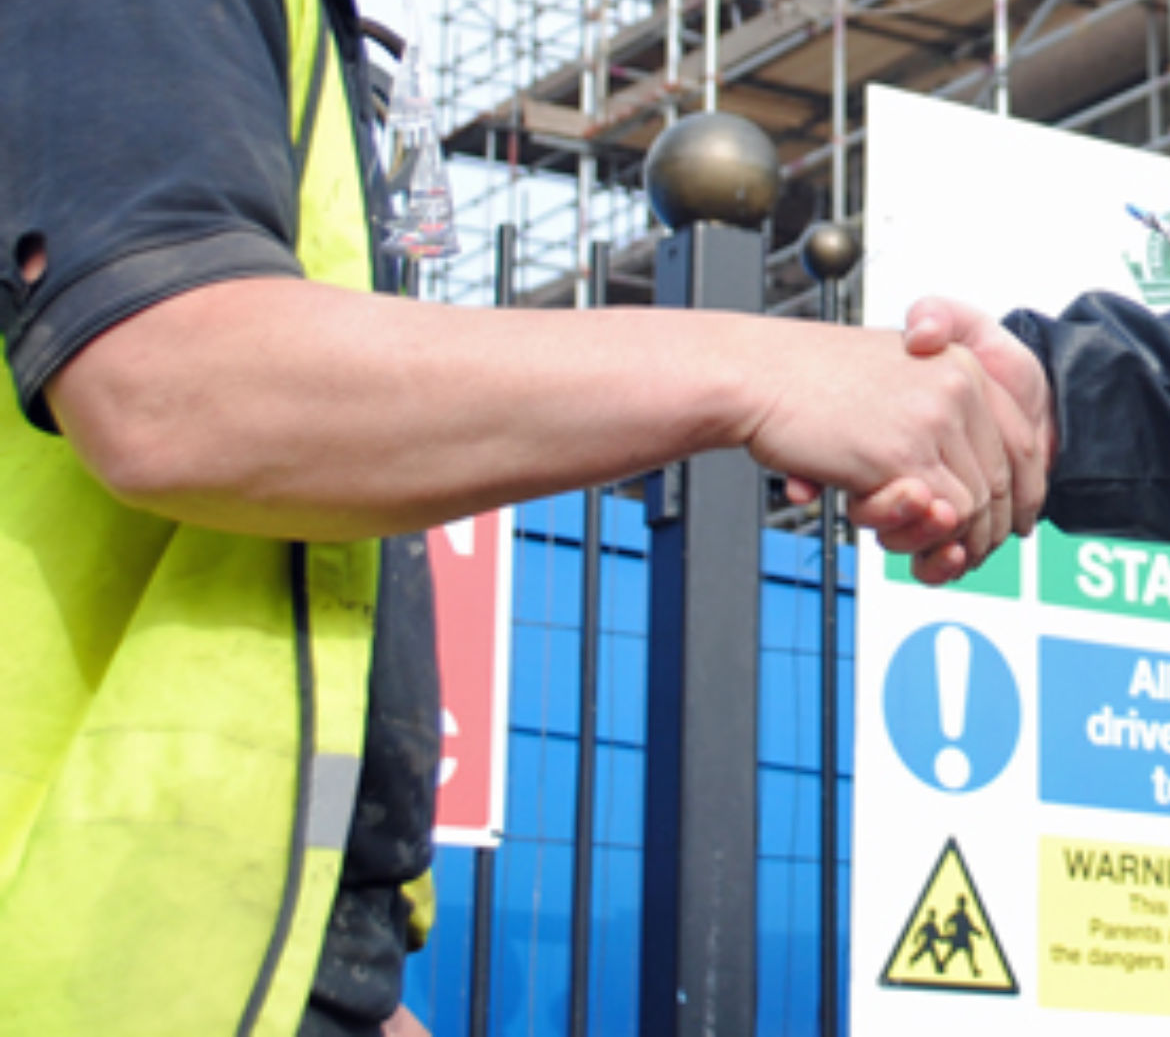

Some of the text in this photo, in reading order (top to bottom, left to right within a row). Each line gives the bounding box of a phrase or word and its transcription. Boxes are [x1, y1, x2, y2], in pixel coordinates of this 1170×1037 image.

[1089, 917, 1163, 944] Parents
[1049, 943, 1081, 965] the
[1087, 948, 1164, 974] dangers
